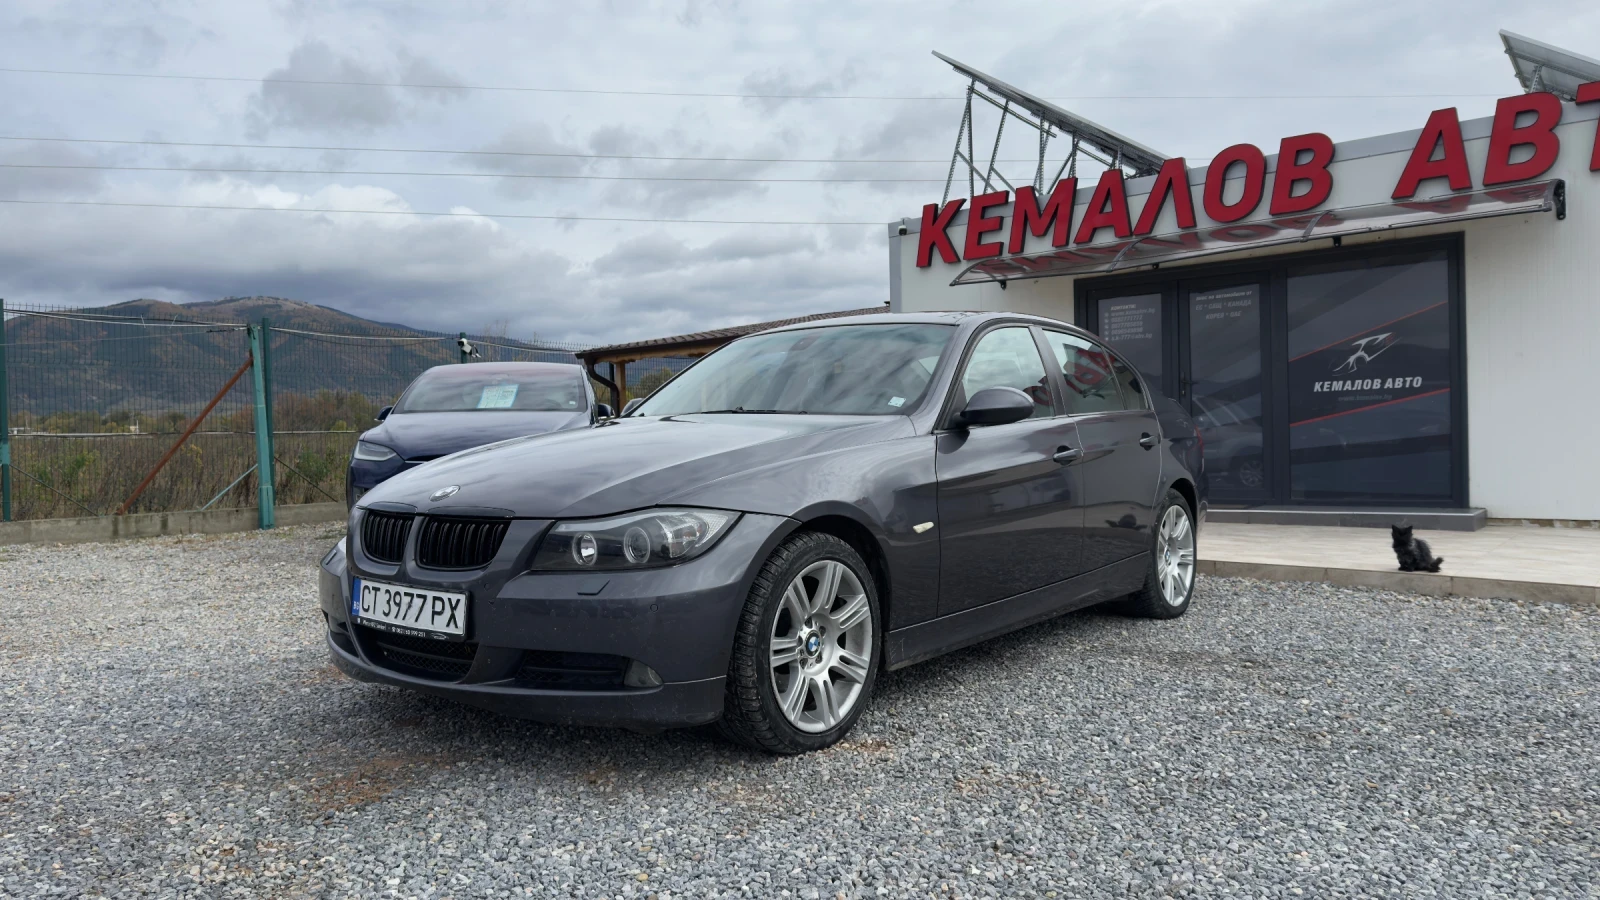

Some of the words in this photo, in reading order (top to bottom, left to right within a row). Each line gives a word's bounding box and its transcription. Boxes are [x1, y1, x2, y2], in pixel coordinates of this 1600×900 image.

[916, 132, 1335, 268] КЕМАЛОВ
[1313, 379, 1382, 393] КЕМАЛОВ
[1384, 376, 1422, 390] АВТО
[361, 585, 381, 615] CT
[382, 588, 428, 623] 3977
[431, 595, 461, 629] PX
